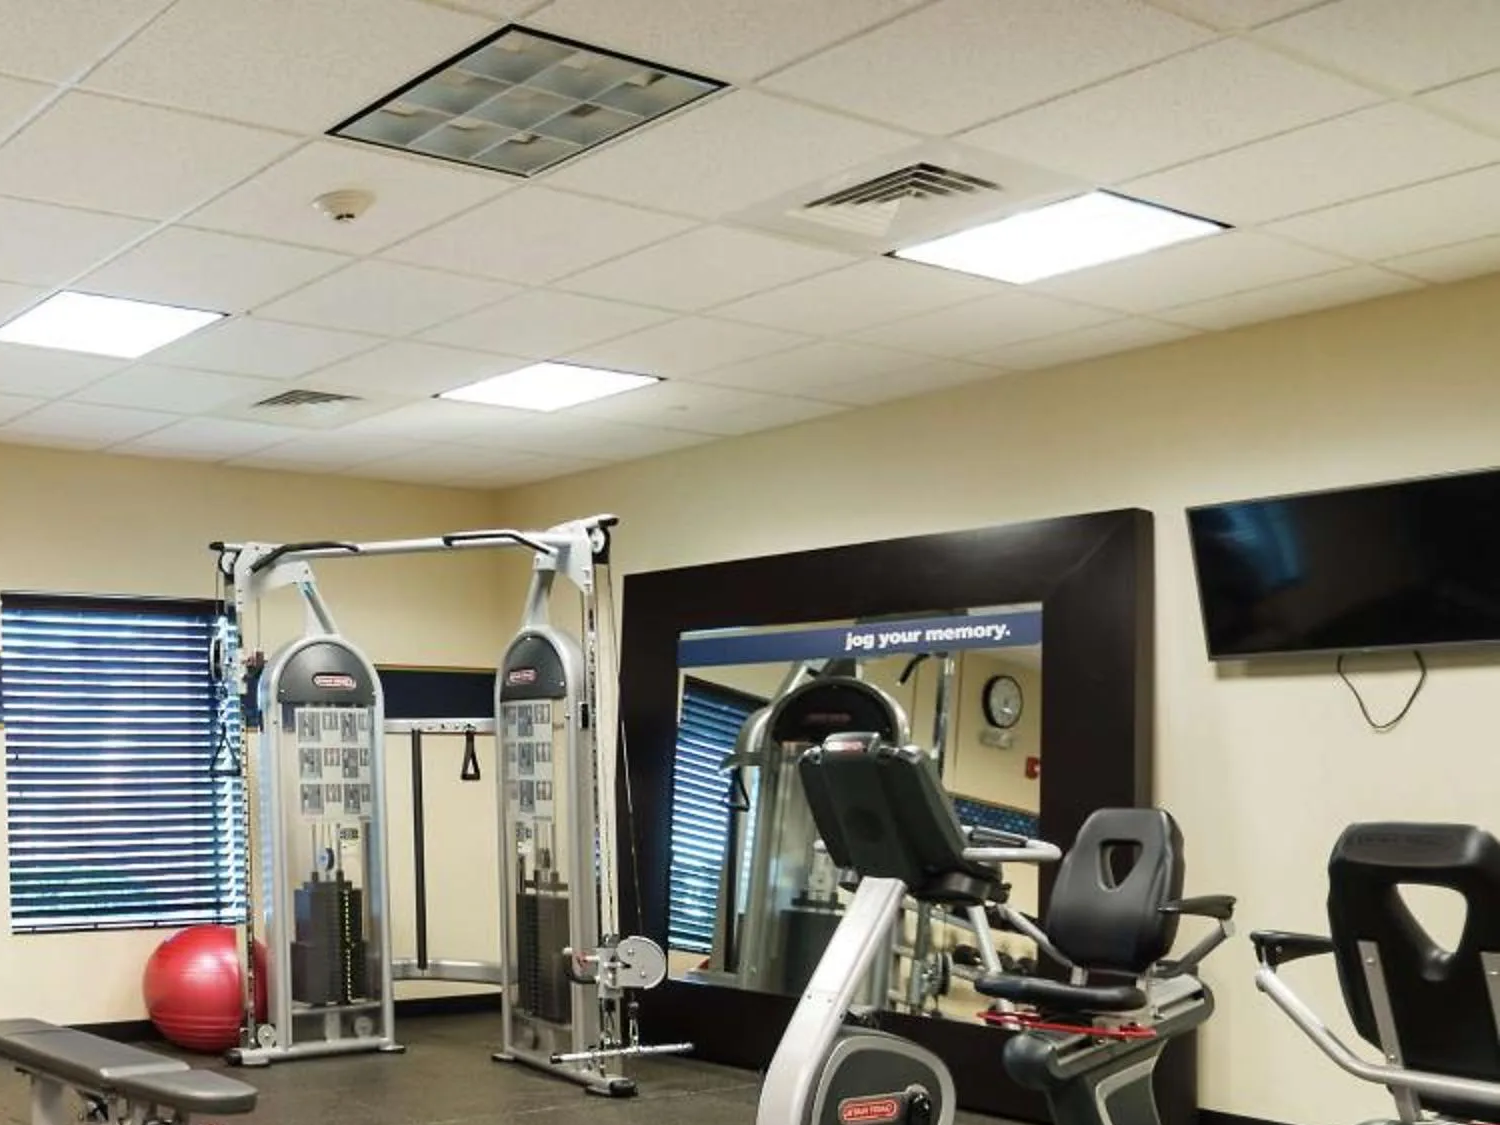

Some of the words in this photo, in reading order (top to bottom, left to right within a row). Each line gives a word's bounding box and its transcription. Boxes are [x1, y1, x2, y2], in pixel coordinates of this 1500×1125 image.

[845, 631, 874, 650] jog
[878, 630, 921, 648] your
[925, 624, 1011, 641] memory.
